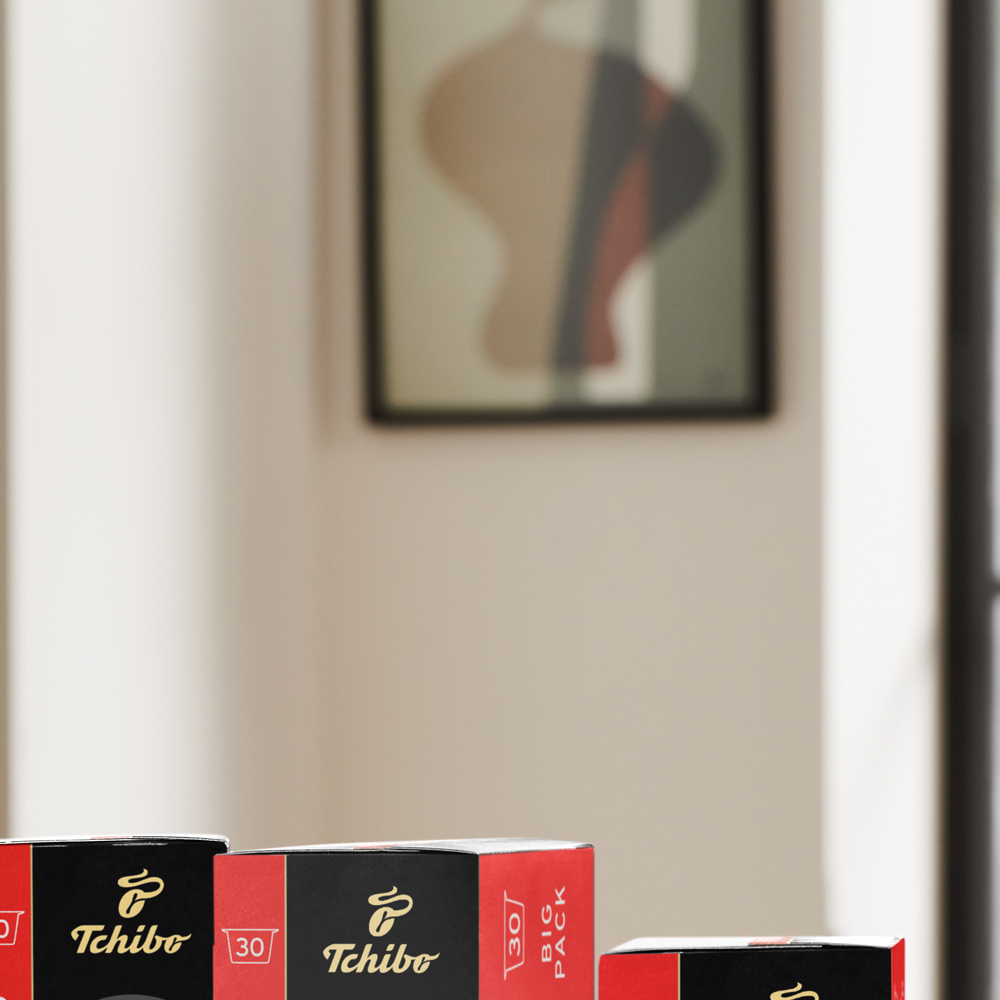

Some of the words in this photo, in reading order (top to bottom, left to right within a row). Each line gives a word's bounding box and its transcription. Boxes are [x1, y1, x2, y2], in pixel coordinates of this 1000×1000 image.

[71, 925, 192, 954] Tchibo
[235, 937, 265, 958] 30
[508, 912, 522, 957] 30
[541, 904, 553, 962] BIG
[554, 886, 566, 979] PACK
[322, 943, 440, 973] Tchibo
